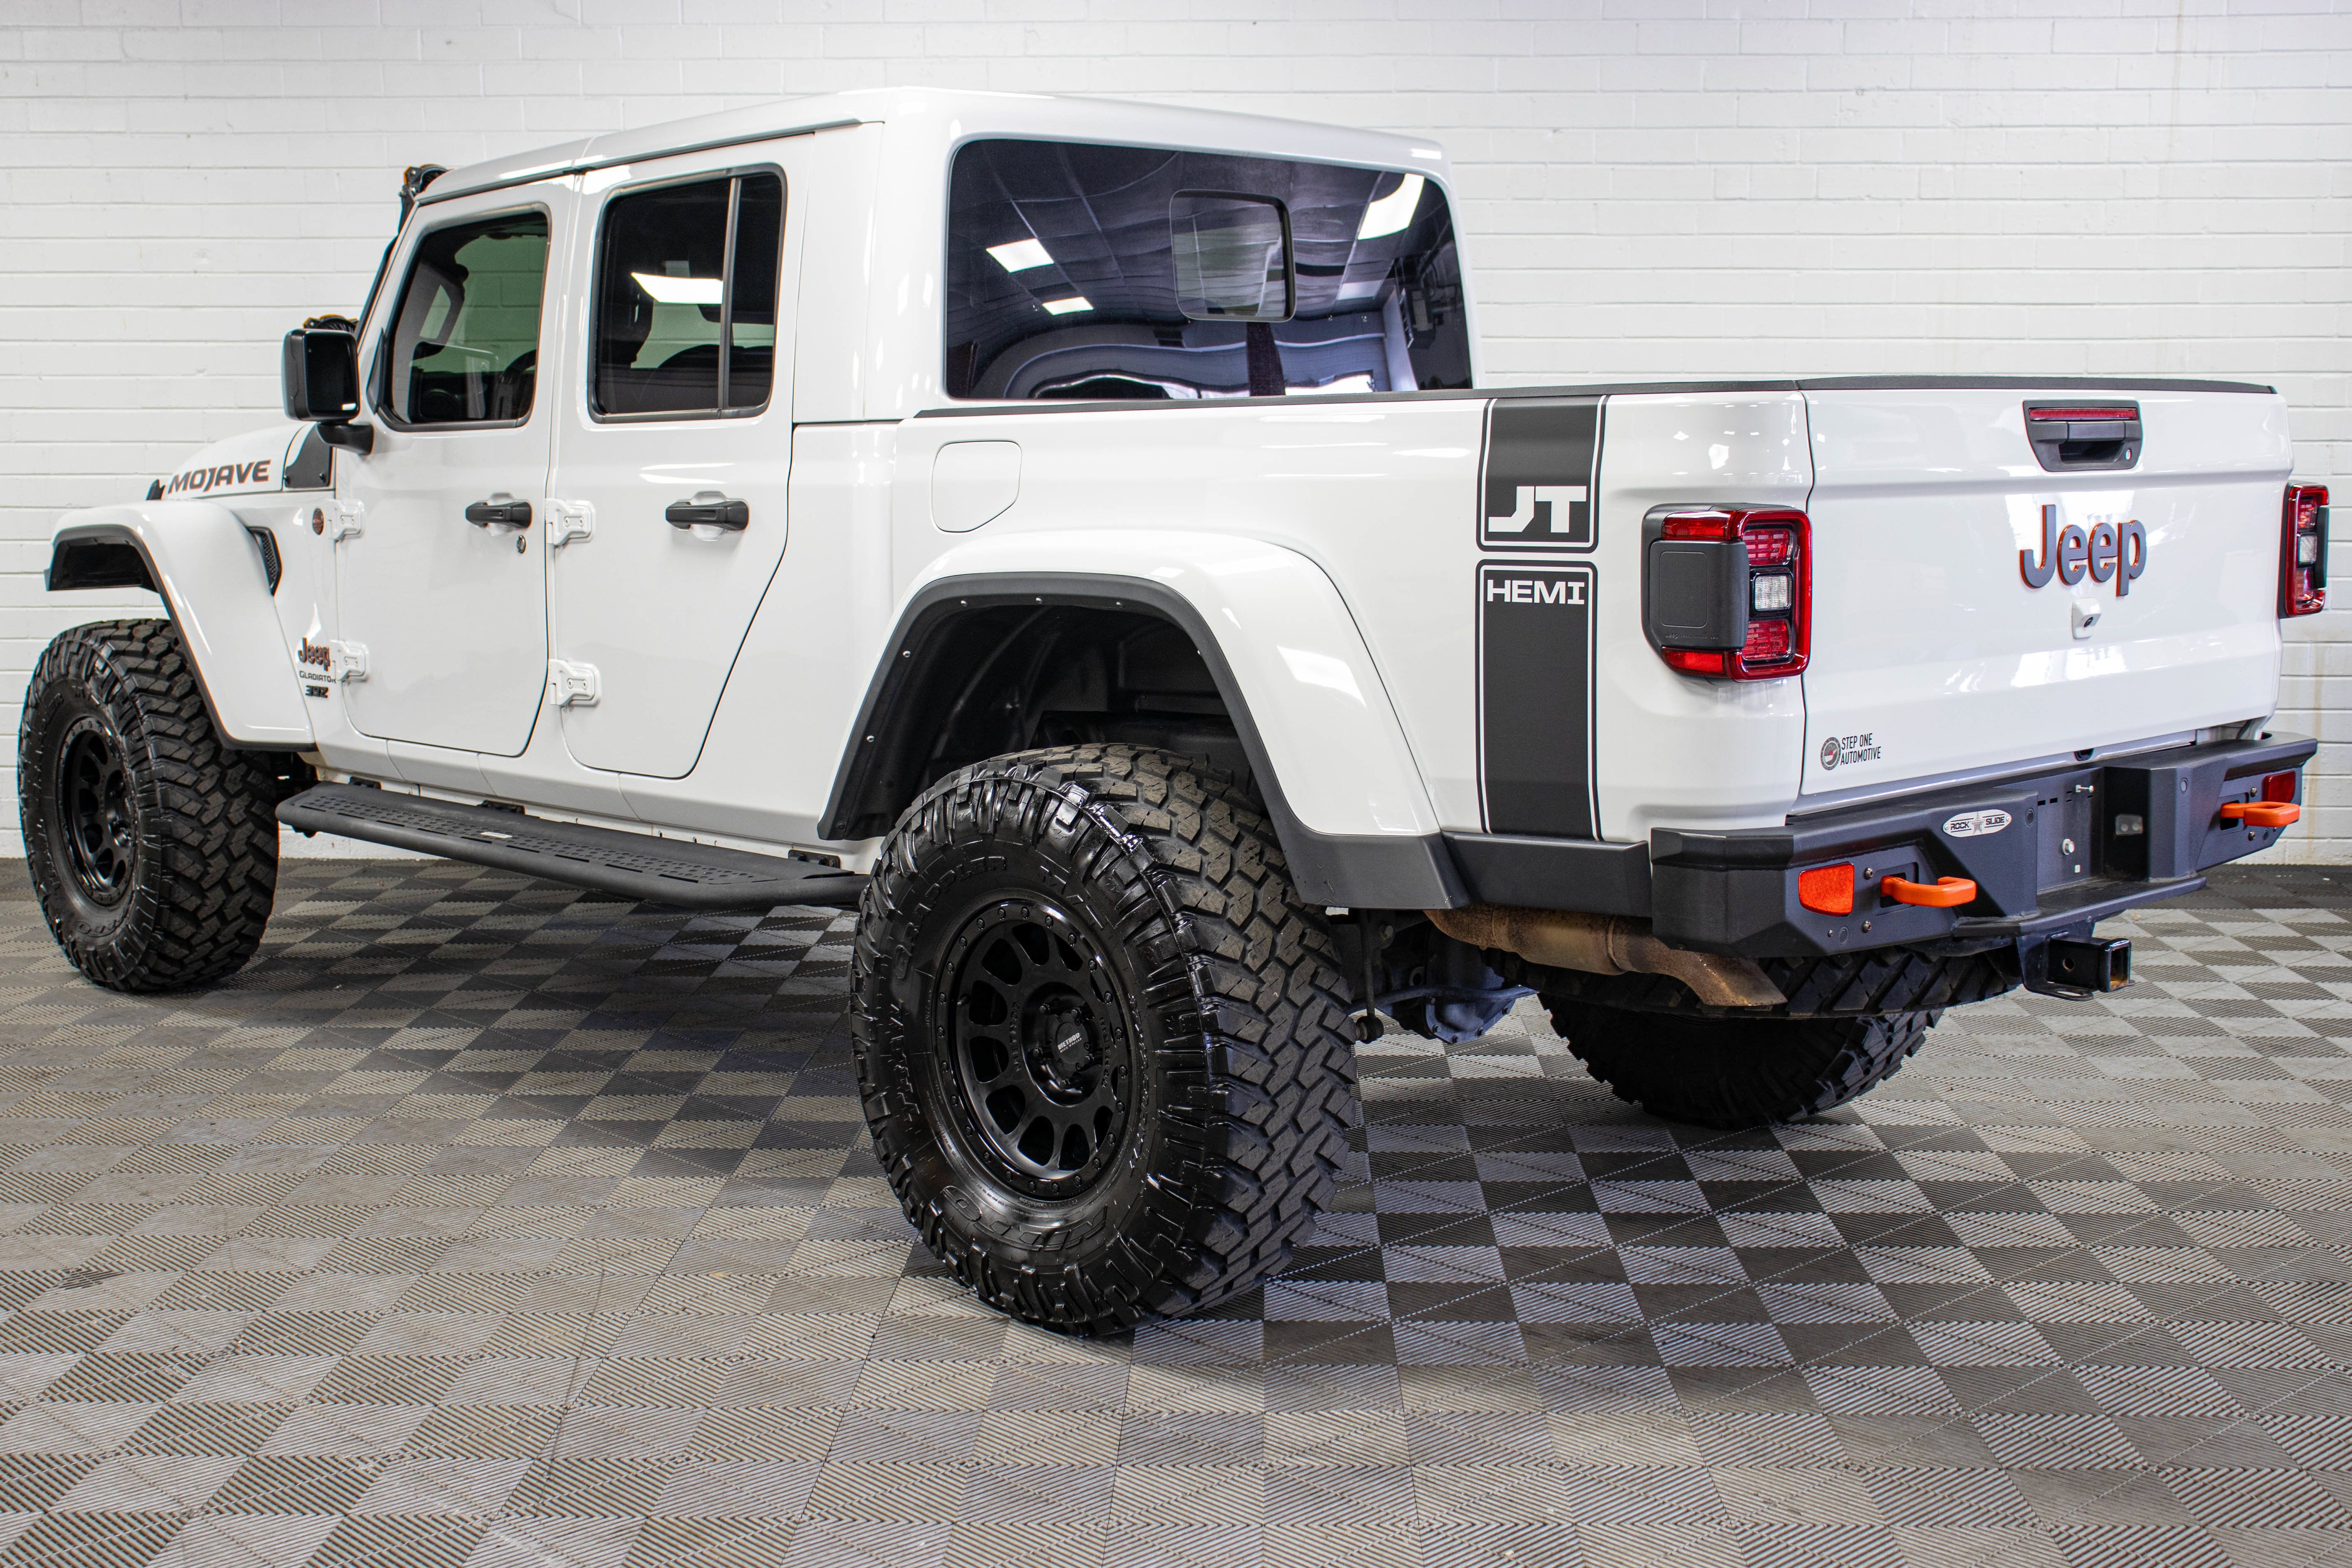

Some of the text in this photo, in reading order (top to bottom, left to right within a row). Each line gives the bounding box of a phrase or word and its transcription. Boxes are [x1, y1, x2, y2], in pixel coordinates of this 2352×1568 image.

[168, 459, 271, 493] MOJAVE
[1488, 486, 1587, 533] JT
[2020, 504, 2147, 597] Jeep
[1487, 580, 1585, 605] HEMI
[297, 637, 331, 671] Jeep
[305, 685, 329, 699] 392
[1841, 733, 1873, 751] STEP ONE
[1840, 746, 1882, 765] AUTOMOTIVE
[1951, 816, 2005, 830] ROCK SLIDE
[894, 856, 1009, 980] GRAPPLER
[1057, 1032, 1080, 1050] METHOD
